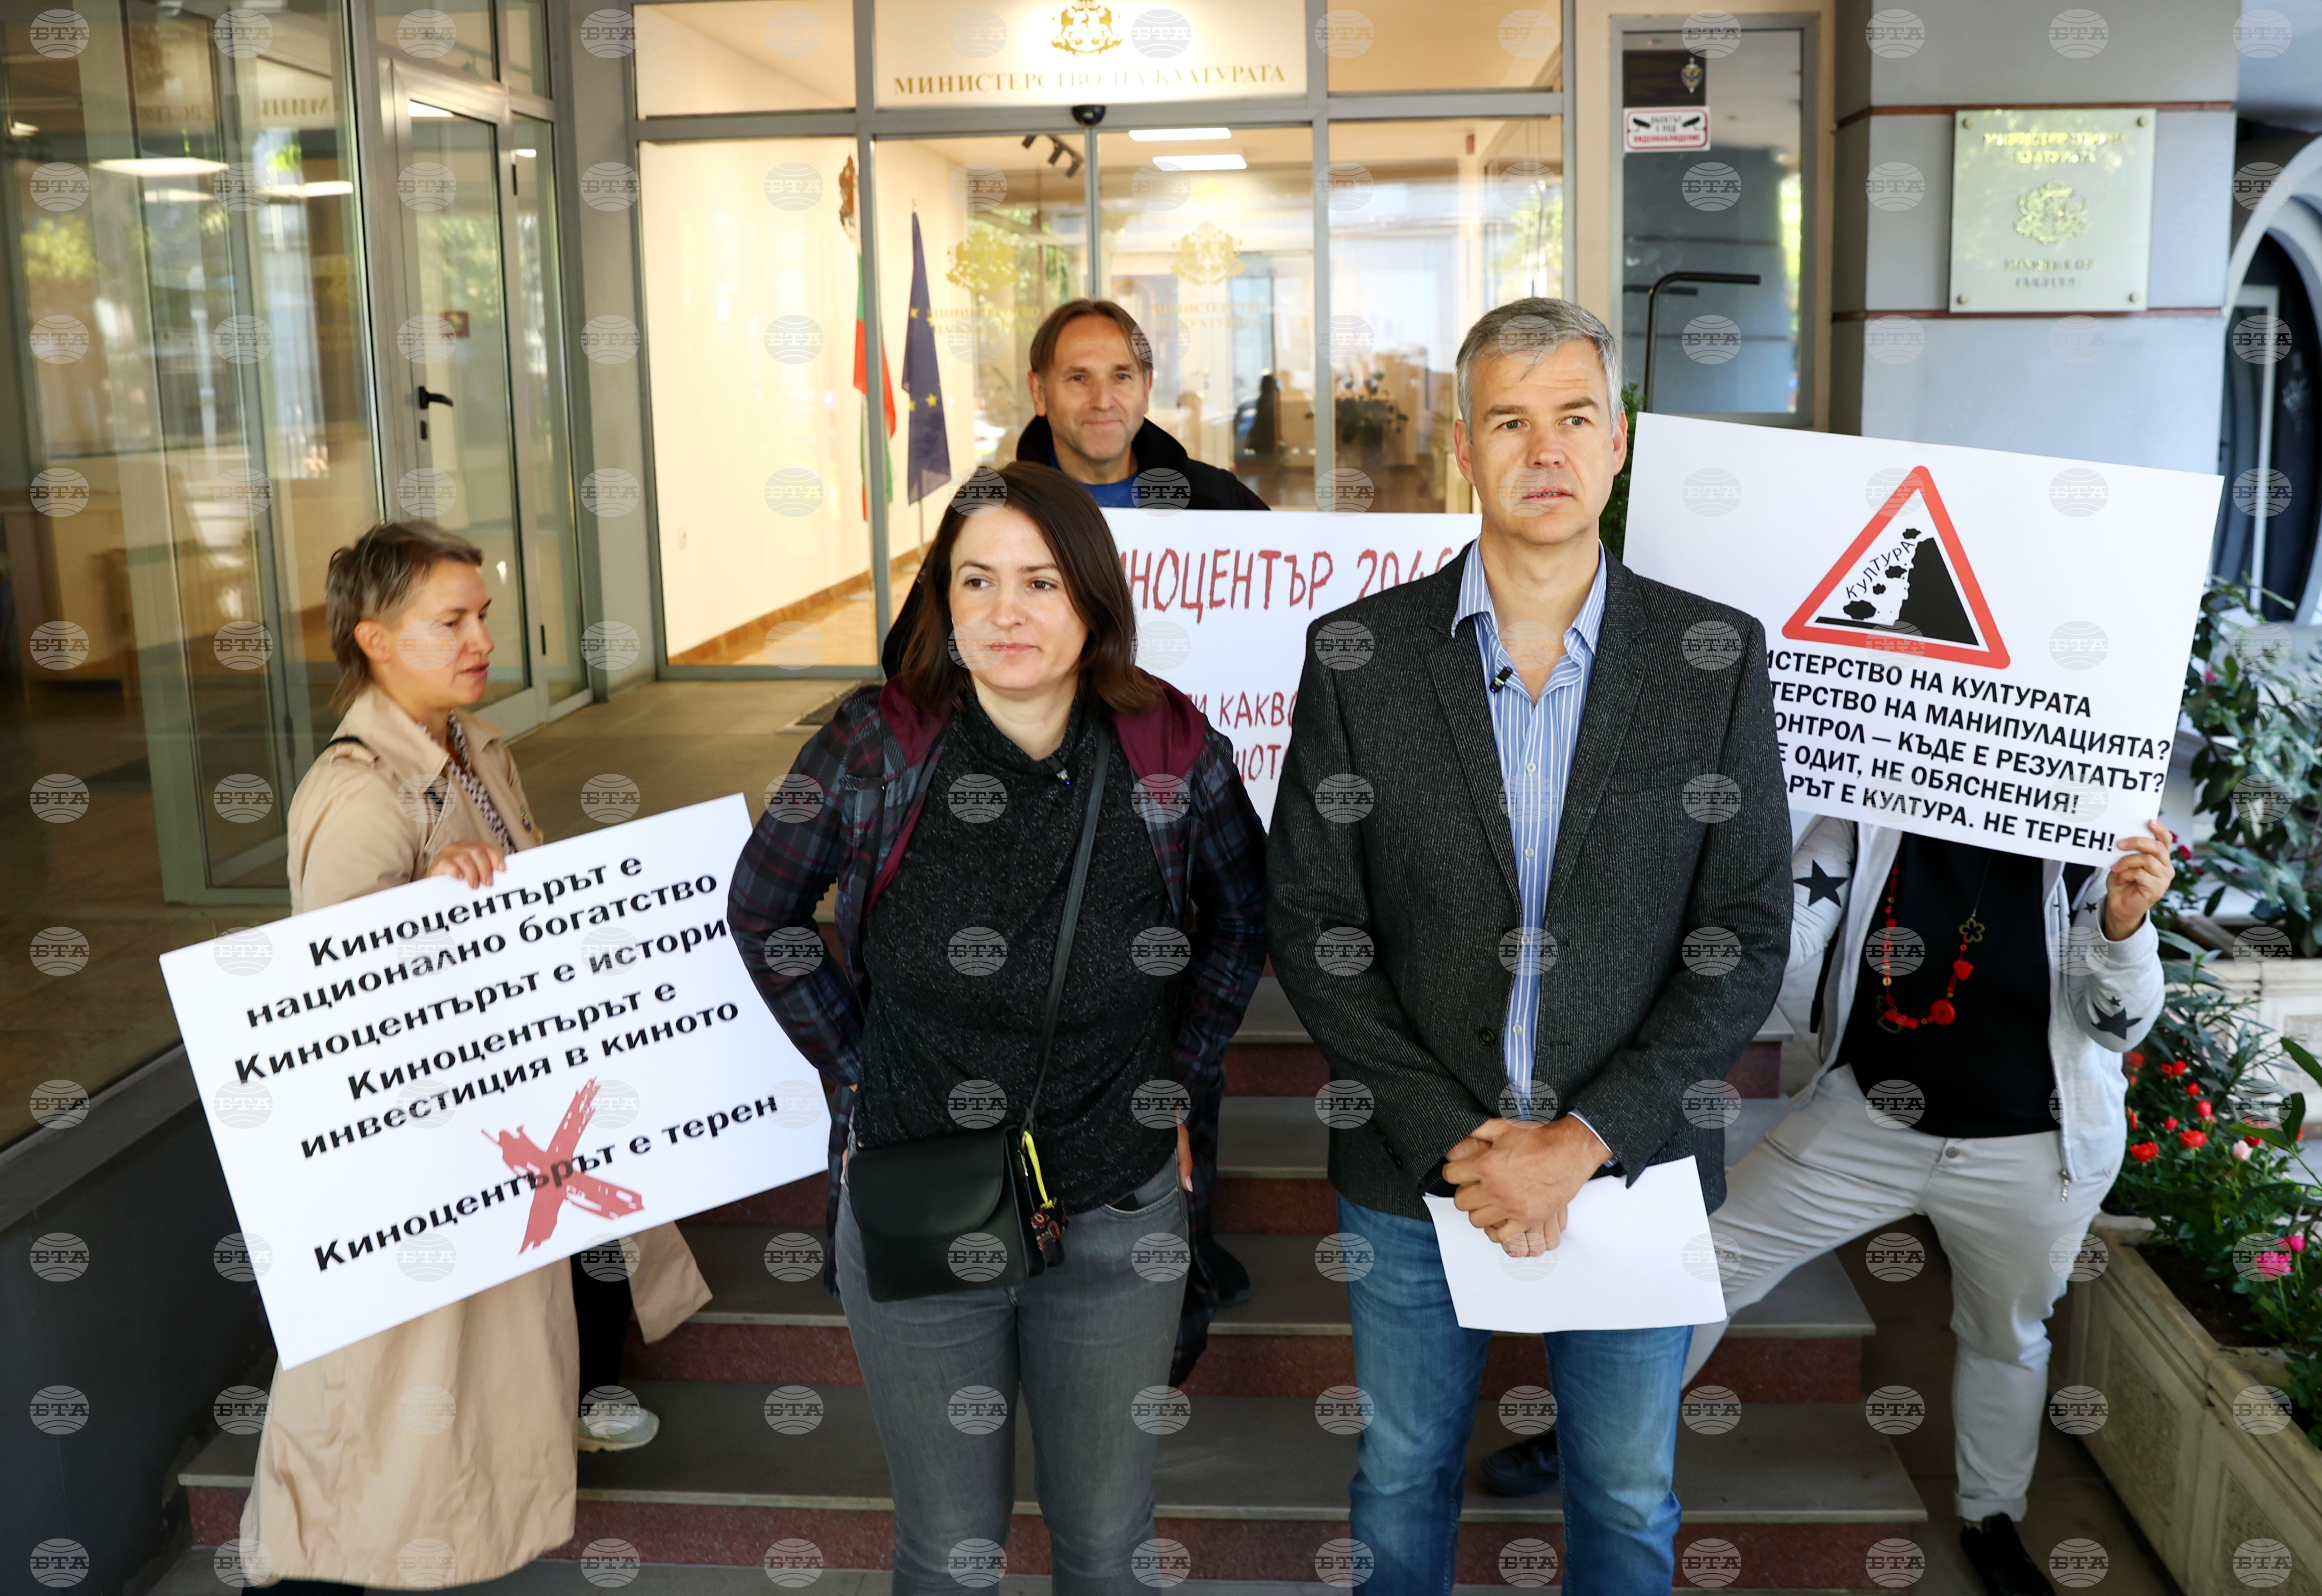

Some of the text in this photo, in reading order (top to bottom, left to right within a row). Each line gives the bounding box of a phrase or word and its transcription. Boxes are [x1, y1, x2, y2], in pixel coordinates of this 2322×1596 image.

[894, 72, 1101, 95] МИНИСТЕРСТВО
[1156, 64, 1285, 85] КУЛТУРАТА
[1846, 541, 1915, 598] КУЛТУРА
[1885, 697, 1916, 721] НА
[1926, 704, 2170, 760] МАНИПУЛАЦИЯТА?
[1911, 669, 1943, 693] НА
[1952, 676, 2090, 717] КУЛТУРАТА
[1795, 746, 1862, 778] ОДИТ,
[1871, 758, 1904, 782] НЕ
[1912, 766, 2079, 814] ОБЯСНЕНИЯ!
[1898, 731, 1966, 763] КЪДЕ
[1973, 745, 1989, 766] Е
[1996, 749, 2164, 793] РЕЗУЛТАТЪТ?
[1789, 775, 1835, 799] РЪТ
[1841, 783, 1856, 803] Е
[1984, 812, 2018, 835] НЕ
[2027, 819, 2114, 852] ТЕРЕН!
[309, 858, 641, 966] Киноцентърът е
[247, 876, 716, 1027] национално богатство
[235, 920, 727, 1084] Киноцентърът е истори
[301, 1003, 738, 1158] инвестиция в киното
[348, 984, 676, 1100] Киноцентърът е
[315, 1096, 777, 1271] Киноцентърът е терен
